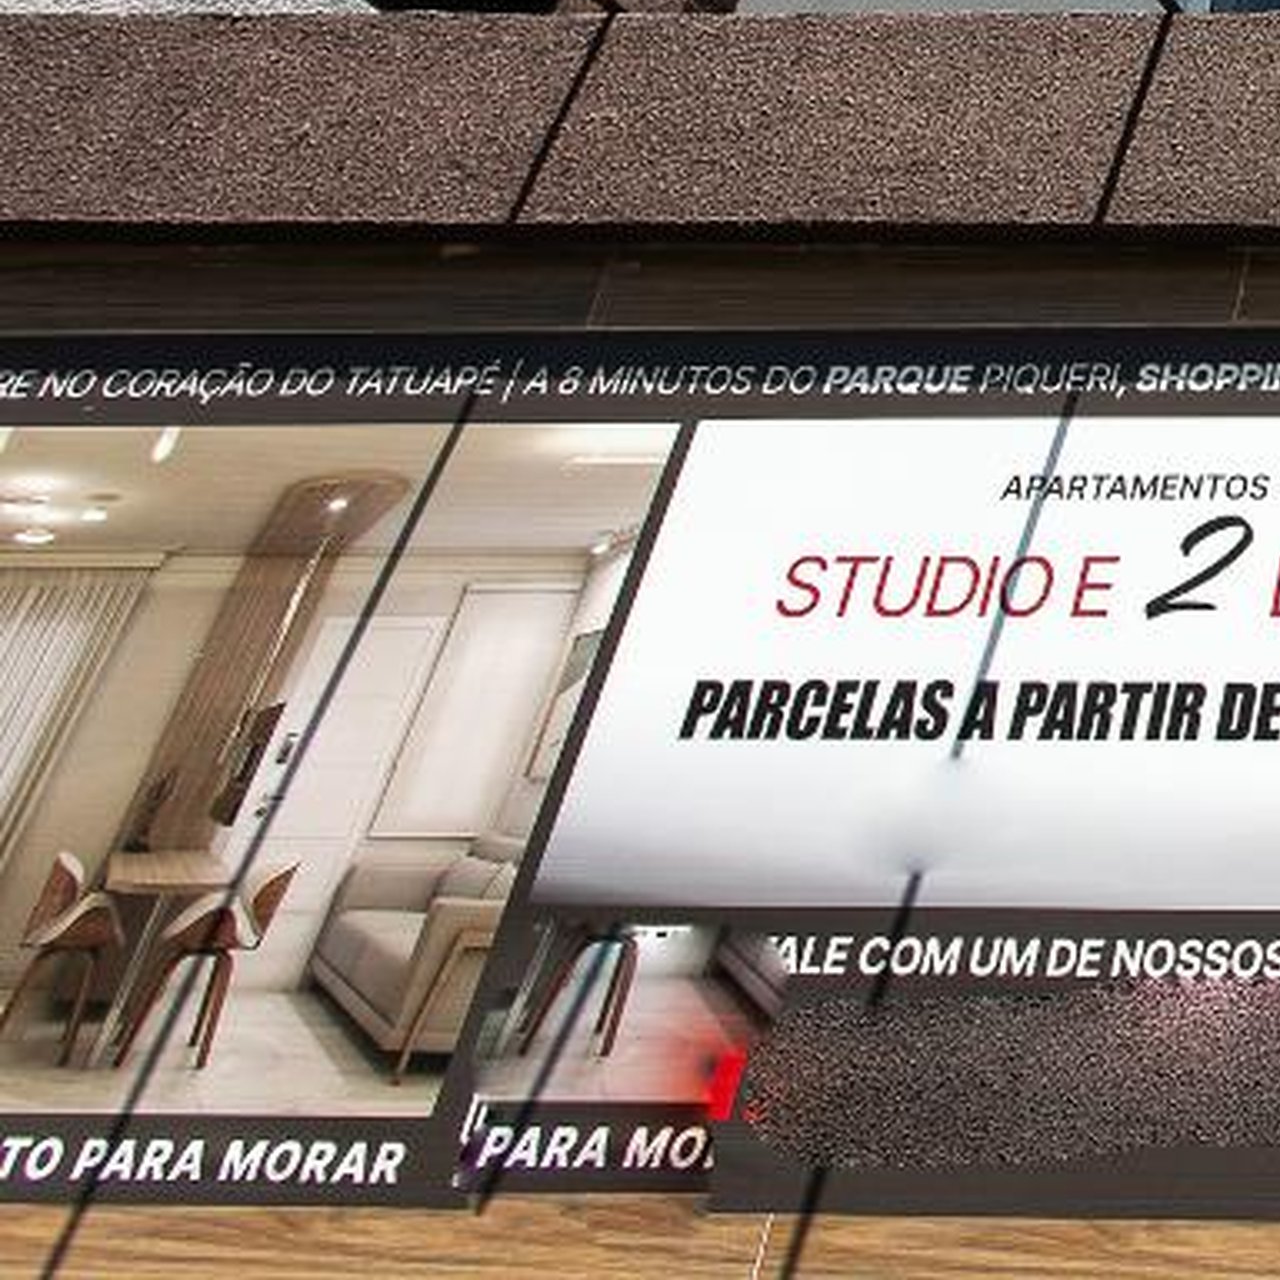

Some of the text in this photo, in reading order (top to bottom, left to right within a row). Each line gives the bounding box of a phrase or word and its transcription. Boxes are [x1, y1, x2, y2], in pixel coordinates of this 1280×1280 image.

[37, 369, 98, 398] NO
[102, 361, 274, 405] CORAÇÃO
[279, 368, 335, 397] DO
[345, 357, 502, 397] TATUAPÉ
[523, 365, 549, 396] A
[557, 365, 585, 396] 8
[588, 365, 756, 396] MINUTOS
[762, 365, 818, 396] DO
[822, 364, 976, 396] PARQUE
[979, 361, 1127, 399] PIQUERI,
[1000, 474, 1271, 501] APARTAMENTOS
[775, 555, 1055, 618] STUDIO
[1069, 555, 1122, 618] E
[1144, 514, 1255, 620] 2
[678, 679, 955, 741] PARCELAS
[955, 680, 1000, 741] A
[1006, 680, 1207, 742] PARTIR
[767, 934, 854, 975] ALE
[858, 935, 964, 976] COM
[968, 936, 1041, 977] UM
[1045, 938, 1107, 978] DE
[68, 1137, 206, 1182] PARA
[217, 1139, 407, 1185] MORAR
[475, 1125, 715, 1170] PARA MO
